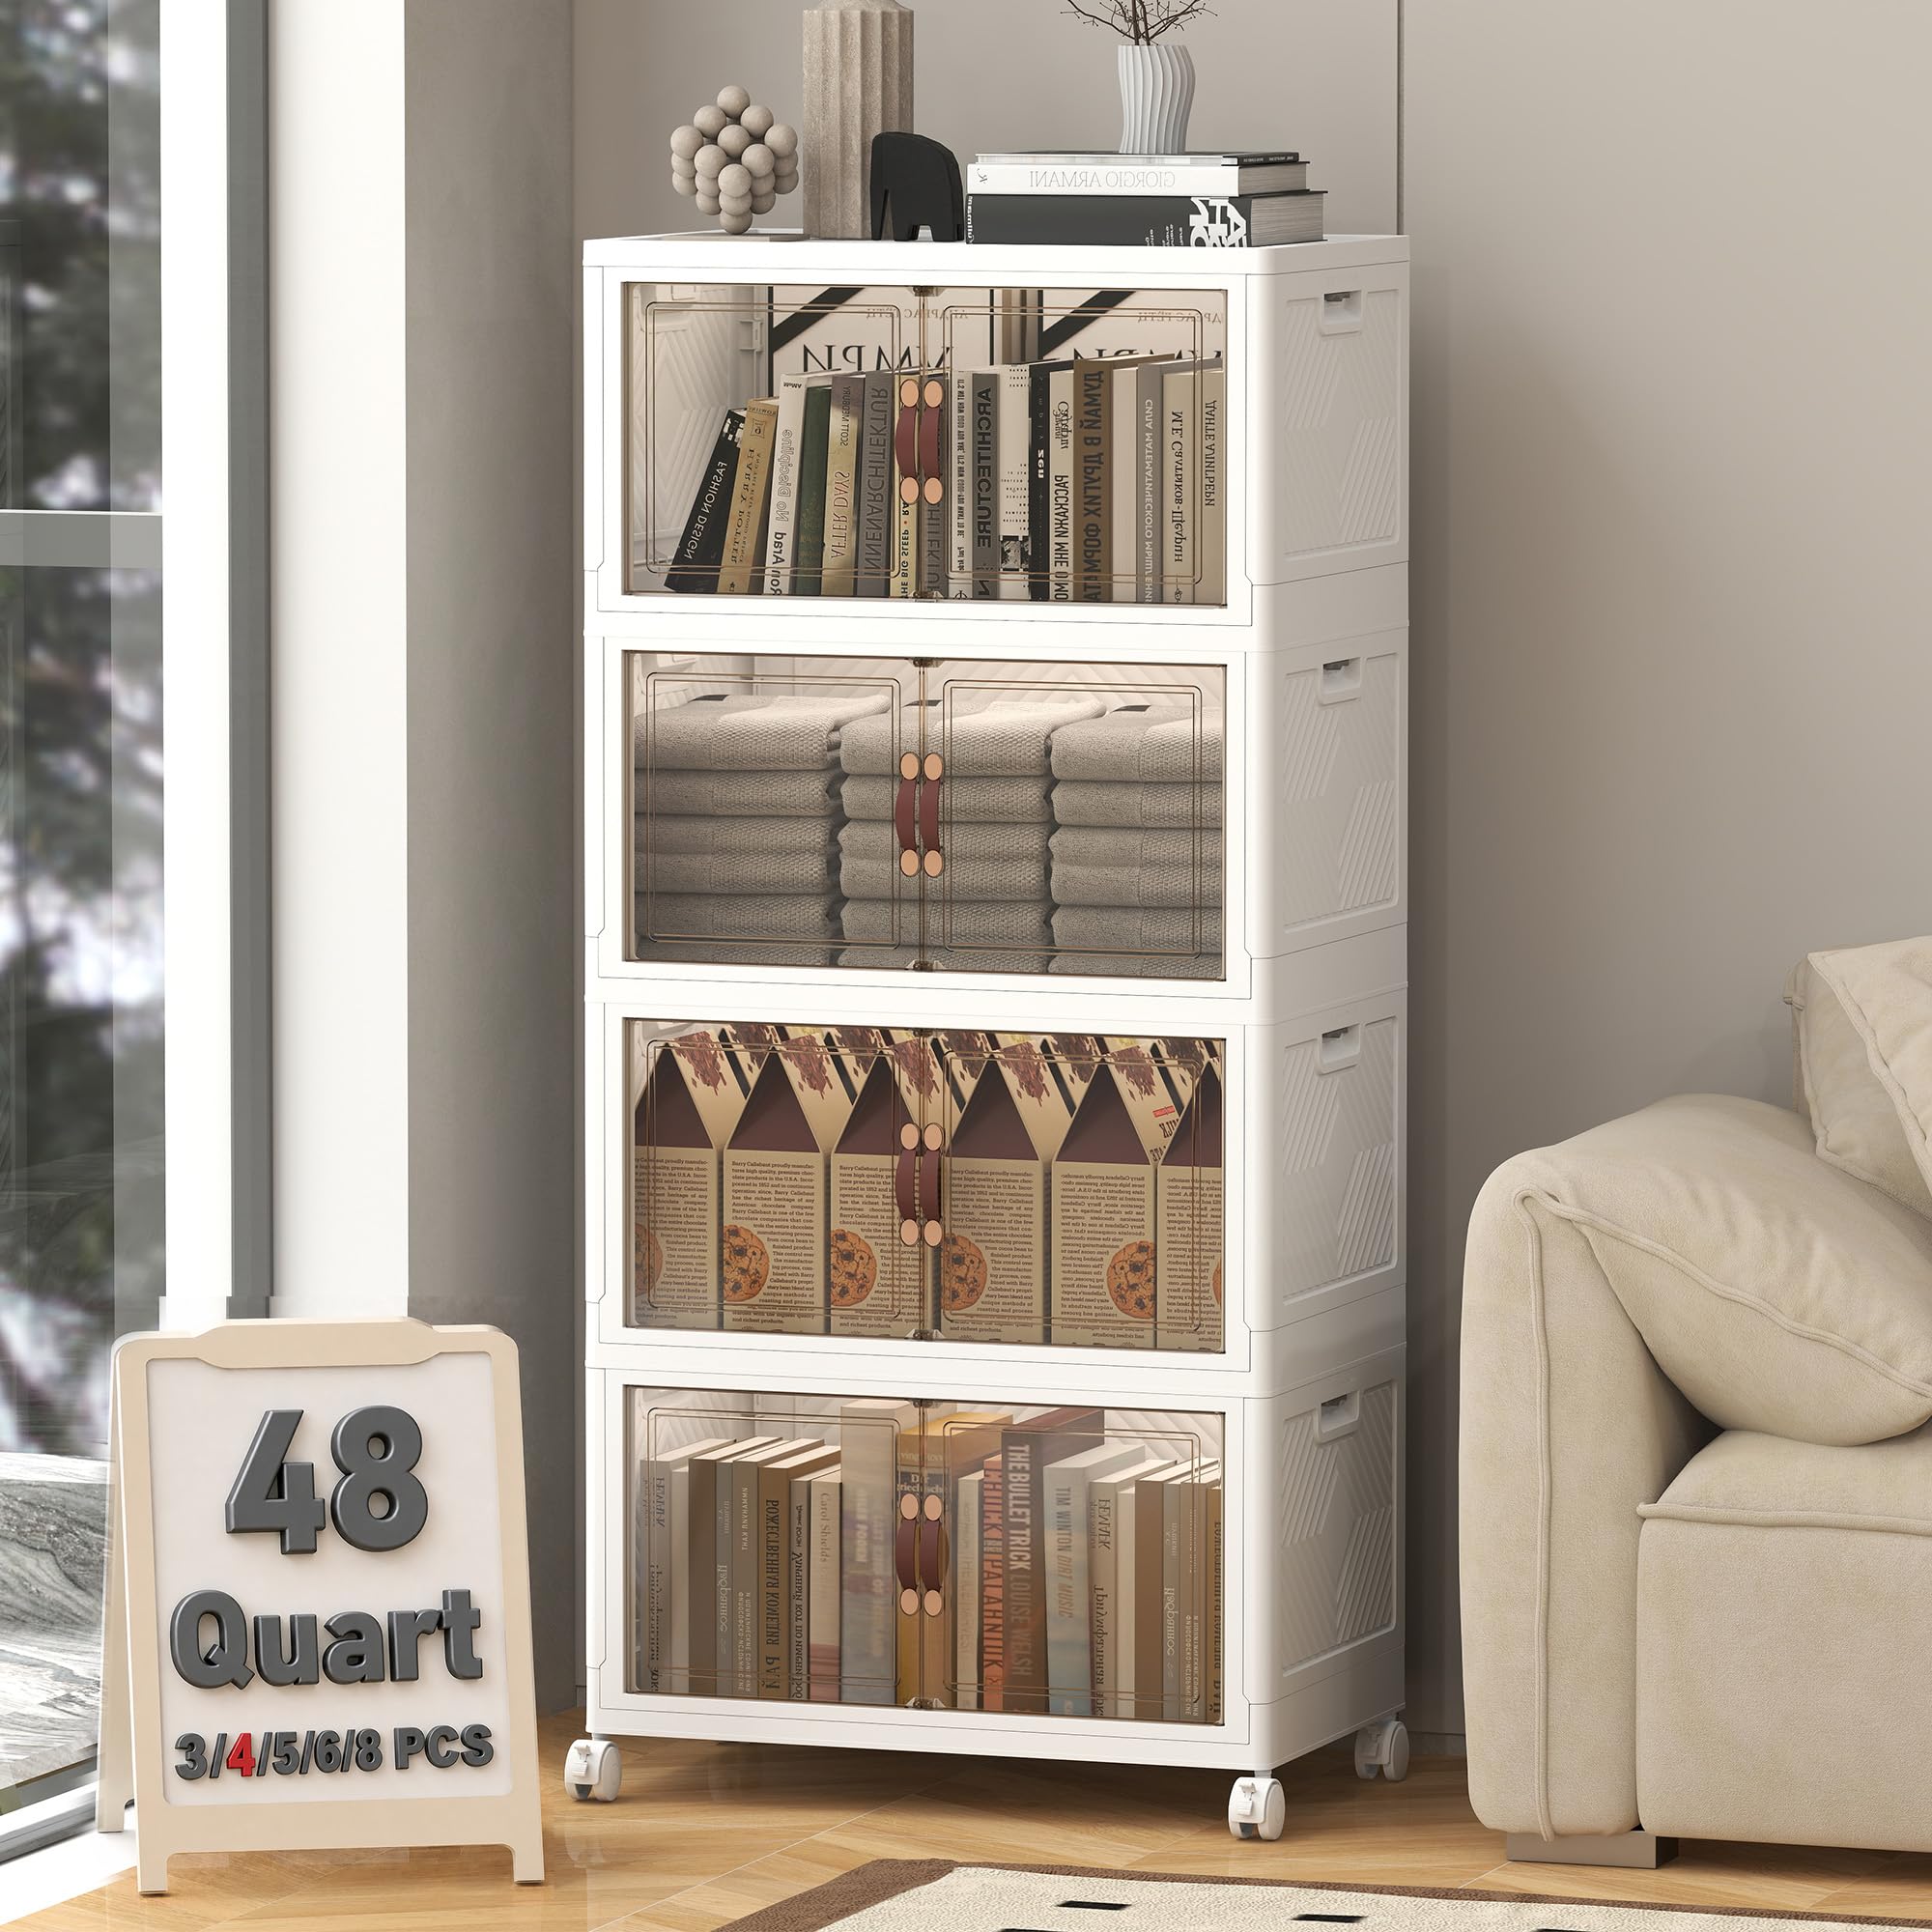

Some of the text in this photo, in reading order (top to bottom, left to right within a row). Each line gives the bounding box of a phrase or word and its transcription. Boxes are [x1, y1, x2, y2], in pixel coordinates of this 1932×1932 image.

[225, 1405, 429, 1556] 48
[818, 1492, 832, 1563] Carol Shields
[1008, 1444, 1033, 1676] THE BULLET TRICK LOUISE WELSH
[1055, 1487, 1074, 1618] TIM WINTON DIRT MUSIC
[169, 1588, 484, 1690] Quart
[173, 1723, 495, 1781] 3/4/5/6/8 PCS
